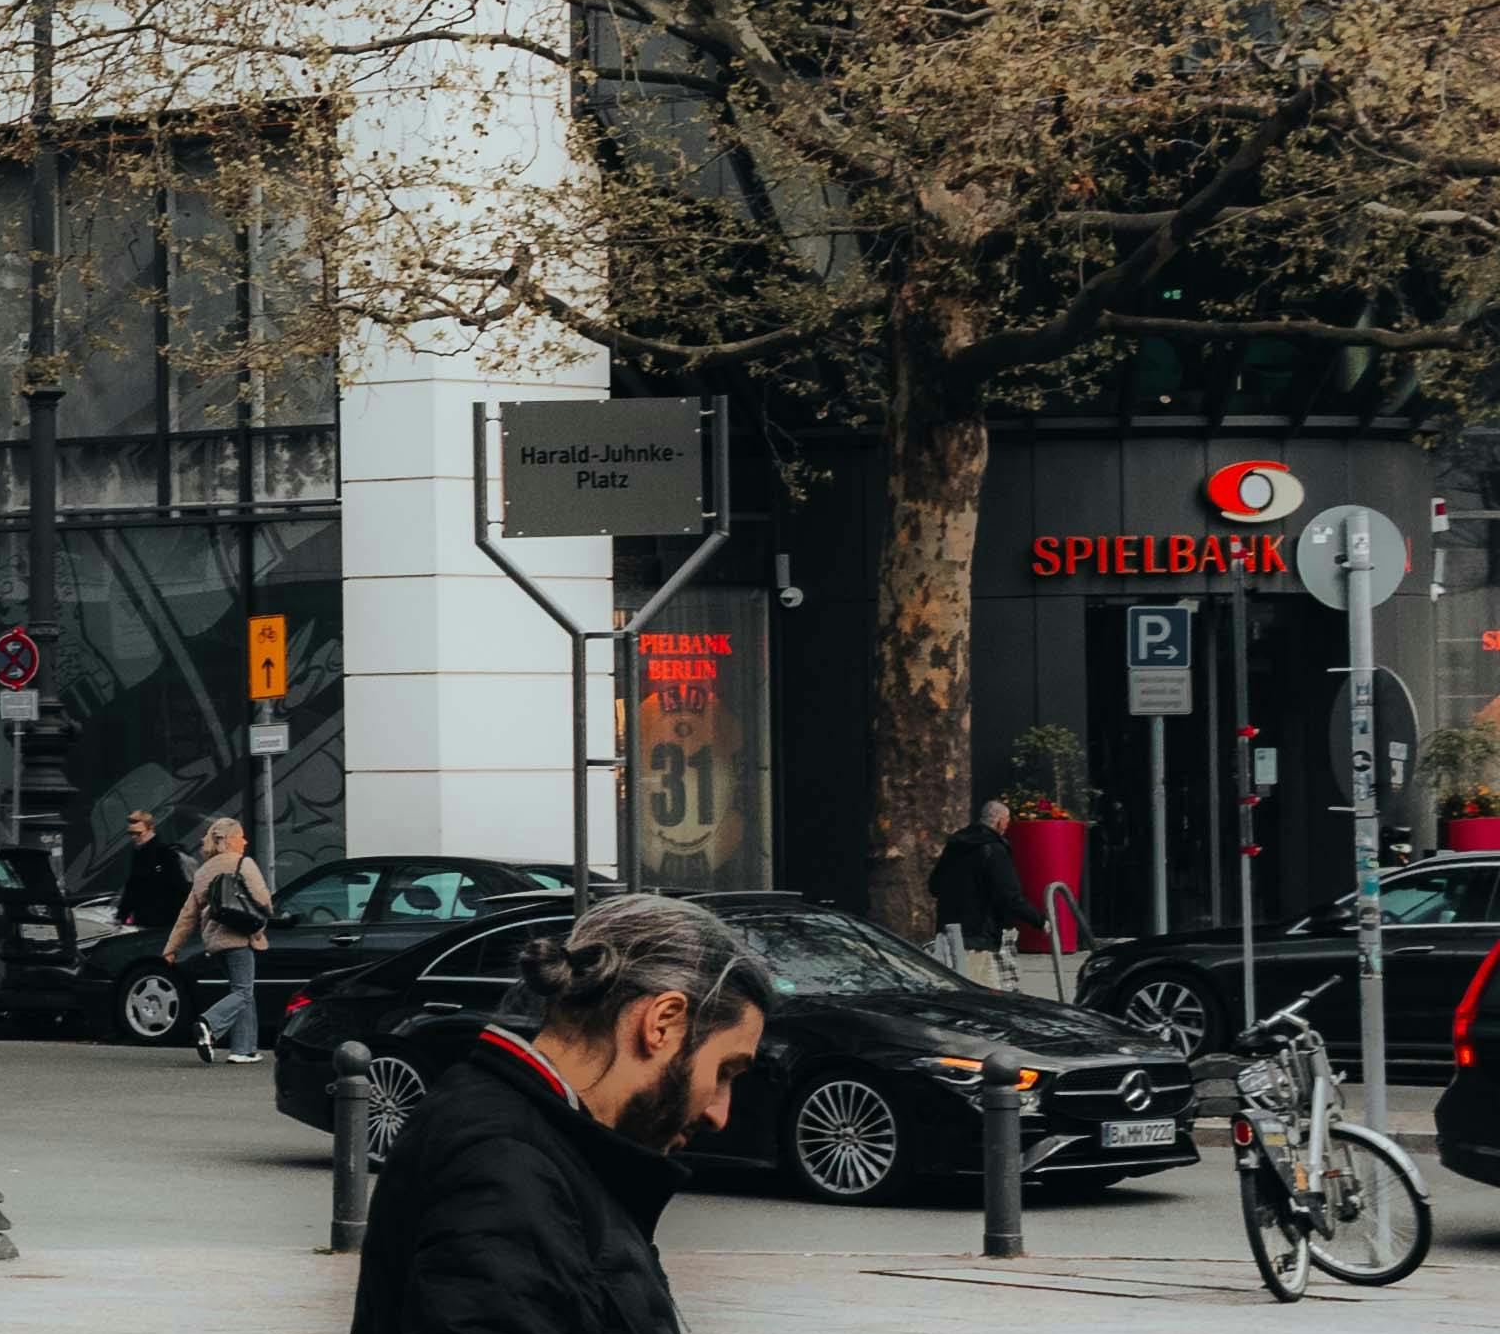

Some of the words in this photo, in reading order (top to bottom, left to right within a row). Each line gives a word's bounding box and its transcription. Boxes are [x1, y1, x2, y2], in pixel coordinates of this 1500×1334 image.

[520, 443, 685, 466] Harald-Juhnke-
[576, 470, 629, 490] Platz
[637, 633, 733, 655] PIELBANK
[1138, 615, 1172, 660] P
[648, 659, 718, 681] BERLIN
[651, 741, 715, 828] 31
